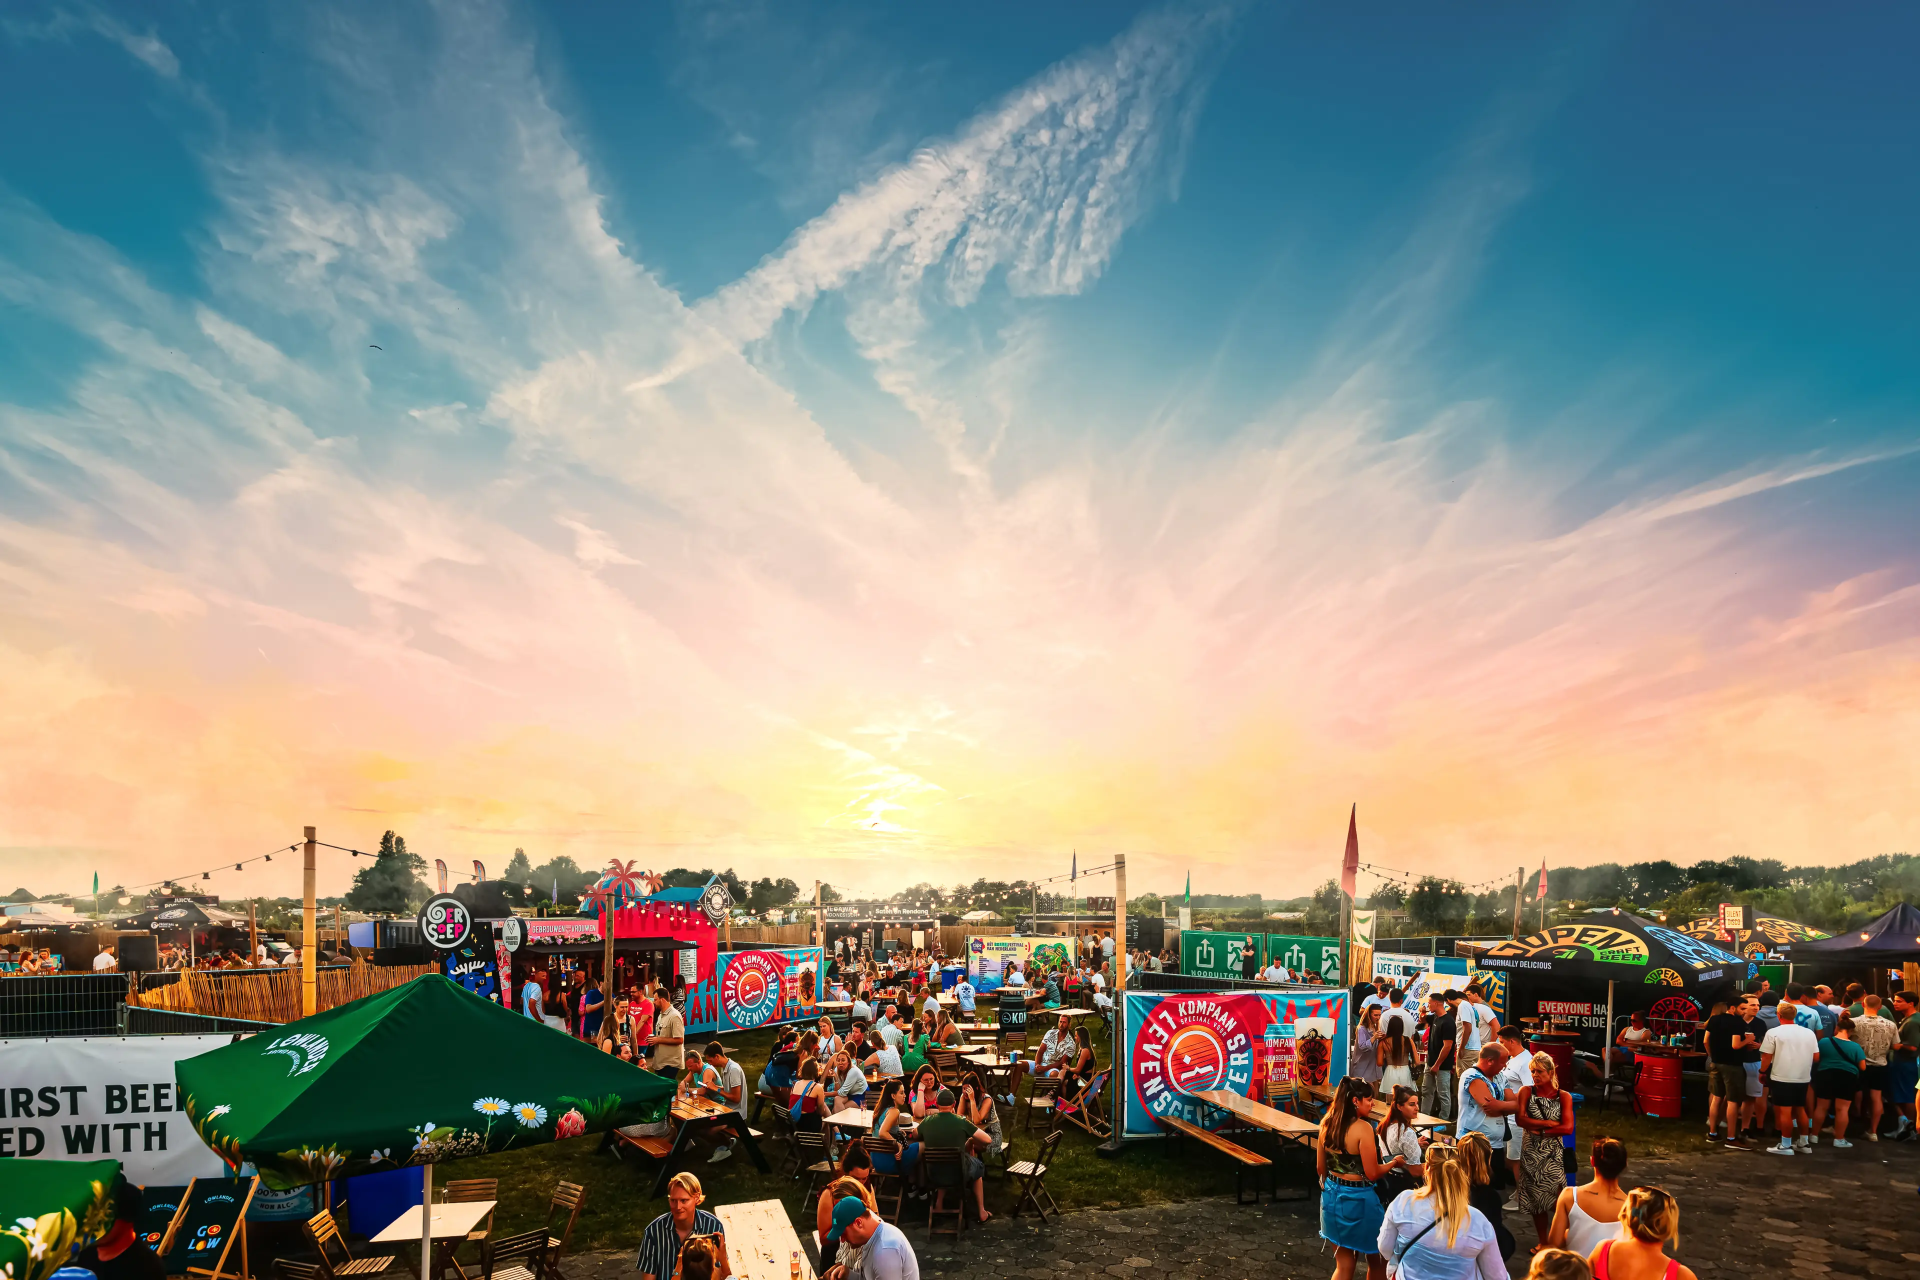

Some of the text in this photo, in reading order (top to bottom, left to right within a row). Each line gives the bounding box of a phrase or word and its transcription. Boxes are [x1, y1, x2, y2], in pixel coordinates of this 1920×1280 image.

[902, 908, 929, 916] Rendang
[1726, 910, 1741, 918] SILENT
[1727, 918, 1741, 926] DISCO
[428, 923, 464, 941] SOEP
[532, 924, 596, 934] GEBROUWEN VROUWEN
[1496, 927, 1636, 957] JOPEN
[1600, 946, 1641, 955] CRAFT
[742, 954, 772, 972] KOMPAAN
[1600, 953, 1643, 961] BEER
[1393, 964, 1401, 976] IS
[1481, 958, 1552, 970] ABNORMALLY DELICIOUS
[1645, 968, 1678, 984] JOPEN
[724, 961, 778, 1026] LEVENSGENIETERS
[1539, 1001, 1591, 1015] EVERYONE
[1650, 998, 1693, 1018] JOPEN
[1178, 1000, 1238, 1032] KOMPAAN
[1180, 1015, 1211, 1025] SPECIAAL
[1581, 1016, 1606, 1028] SIDE
[61, 1121, 168, 1155] WITH
[203, 1194, 235, 1204] LOWLANDER
[148, 1203, 178, 1212] LOWLANDER
